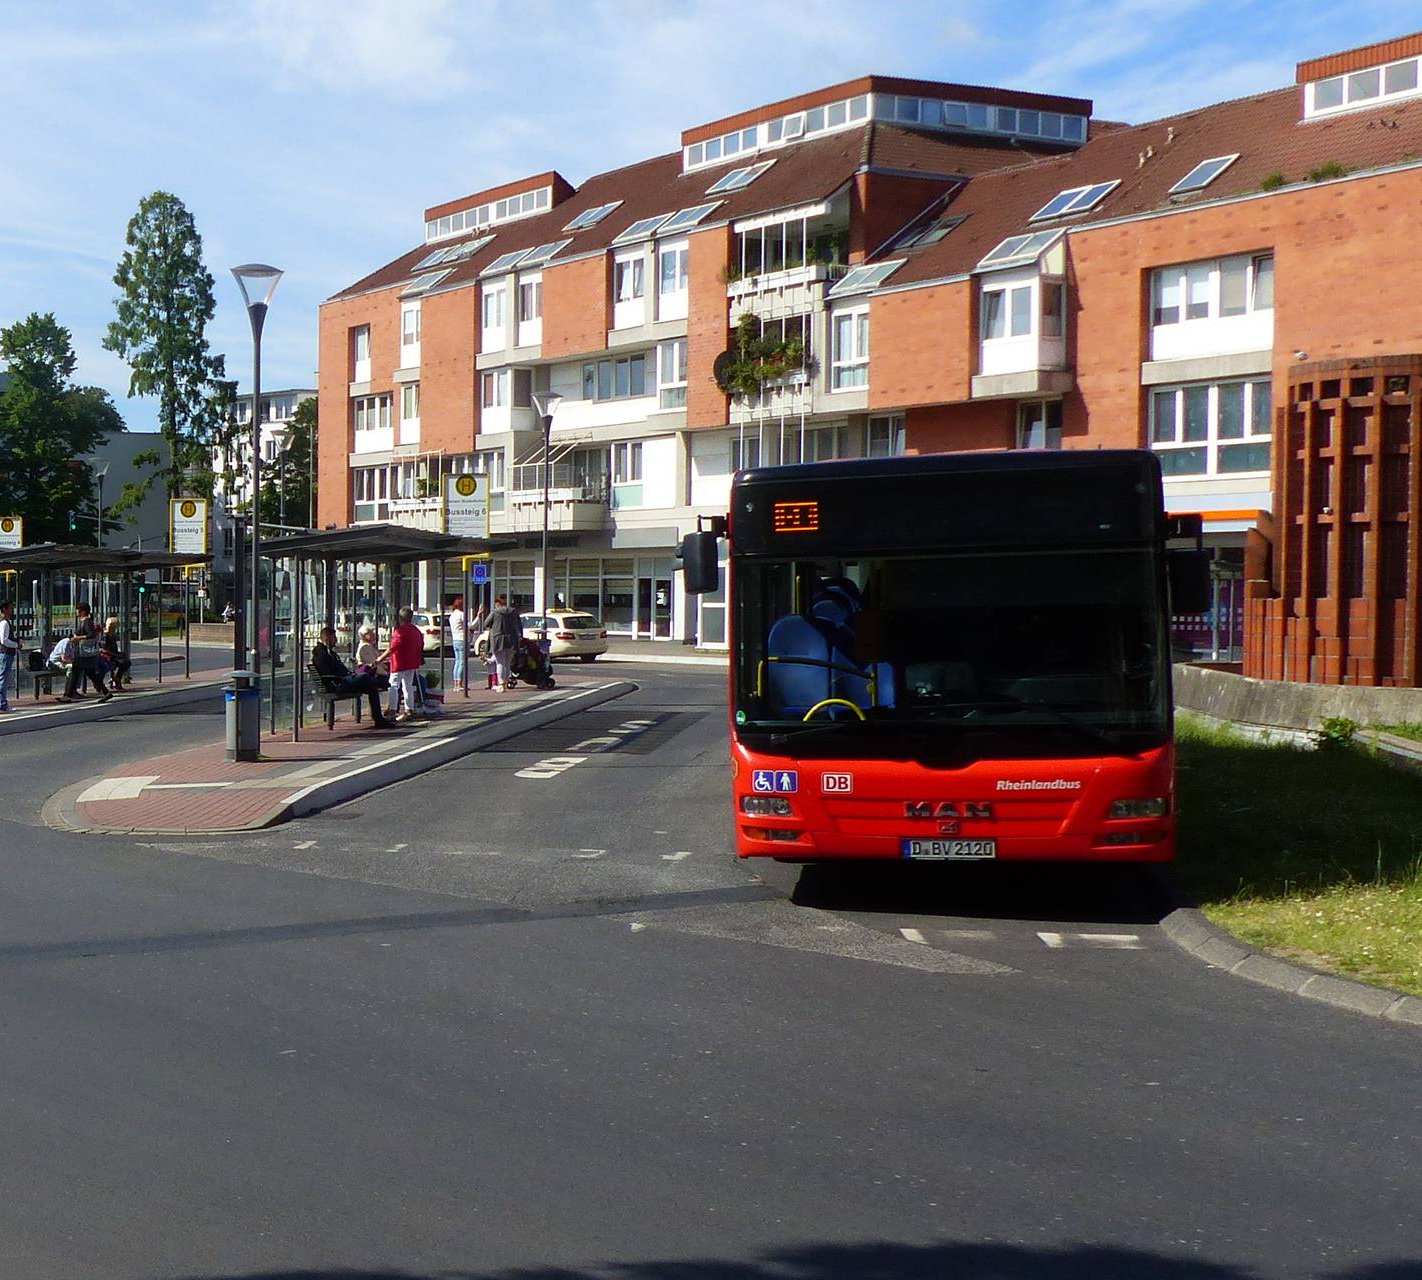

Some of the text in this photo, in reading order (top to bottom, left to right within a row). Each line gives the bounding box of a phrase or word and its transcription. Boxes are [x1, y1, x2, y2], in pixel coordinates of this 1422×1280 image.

[445, 507, 479, 517] Bussteig
[825, 775, 849, 790] DB
[996, 778, 1082, 791] Rheinlandbus
[903, 801, 991, 817] MAN
[954, 841, 993, 856] 2120
